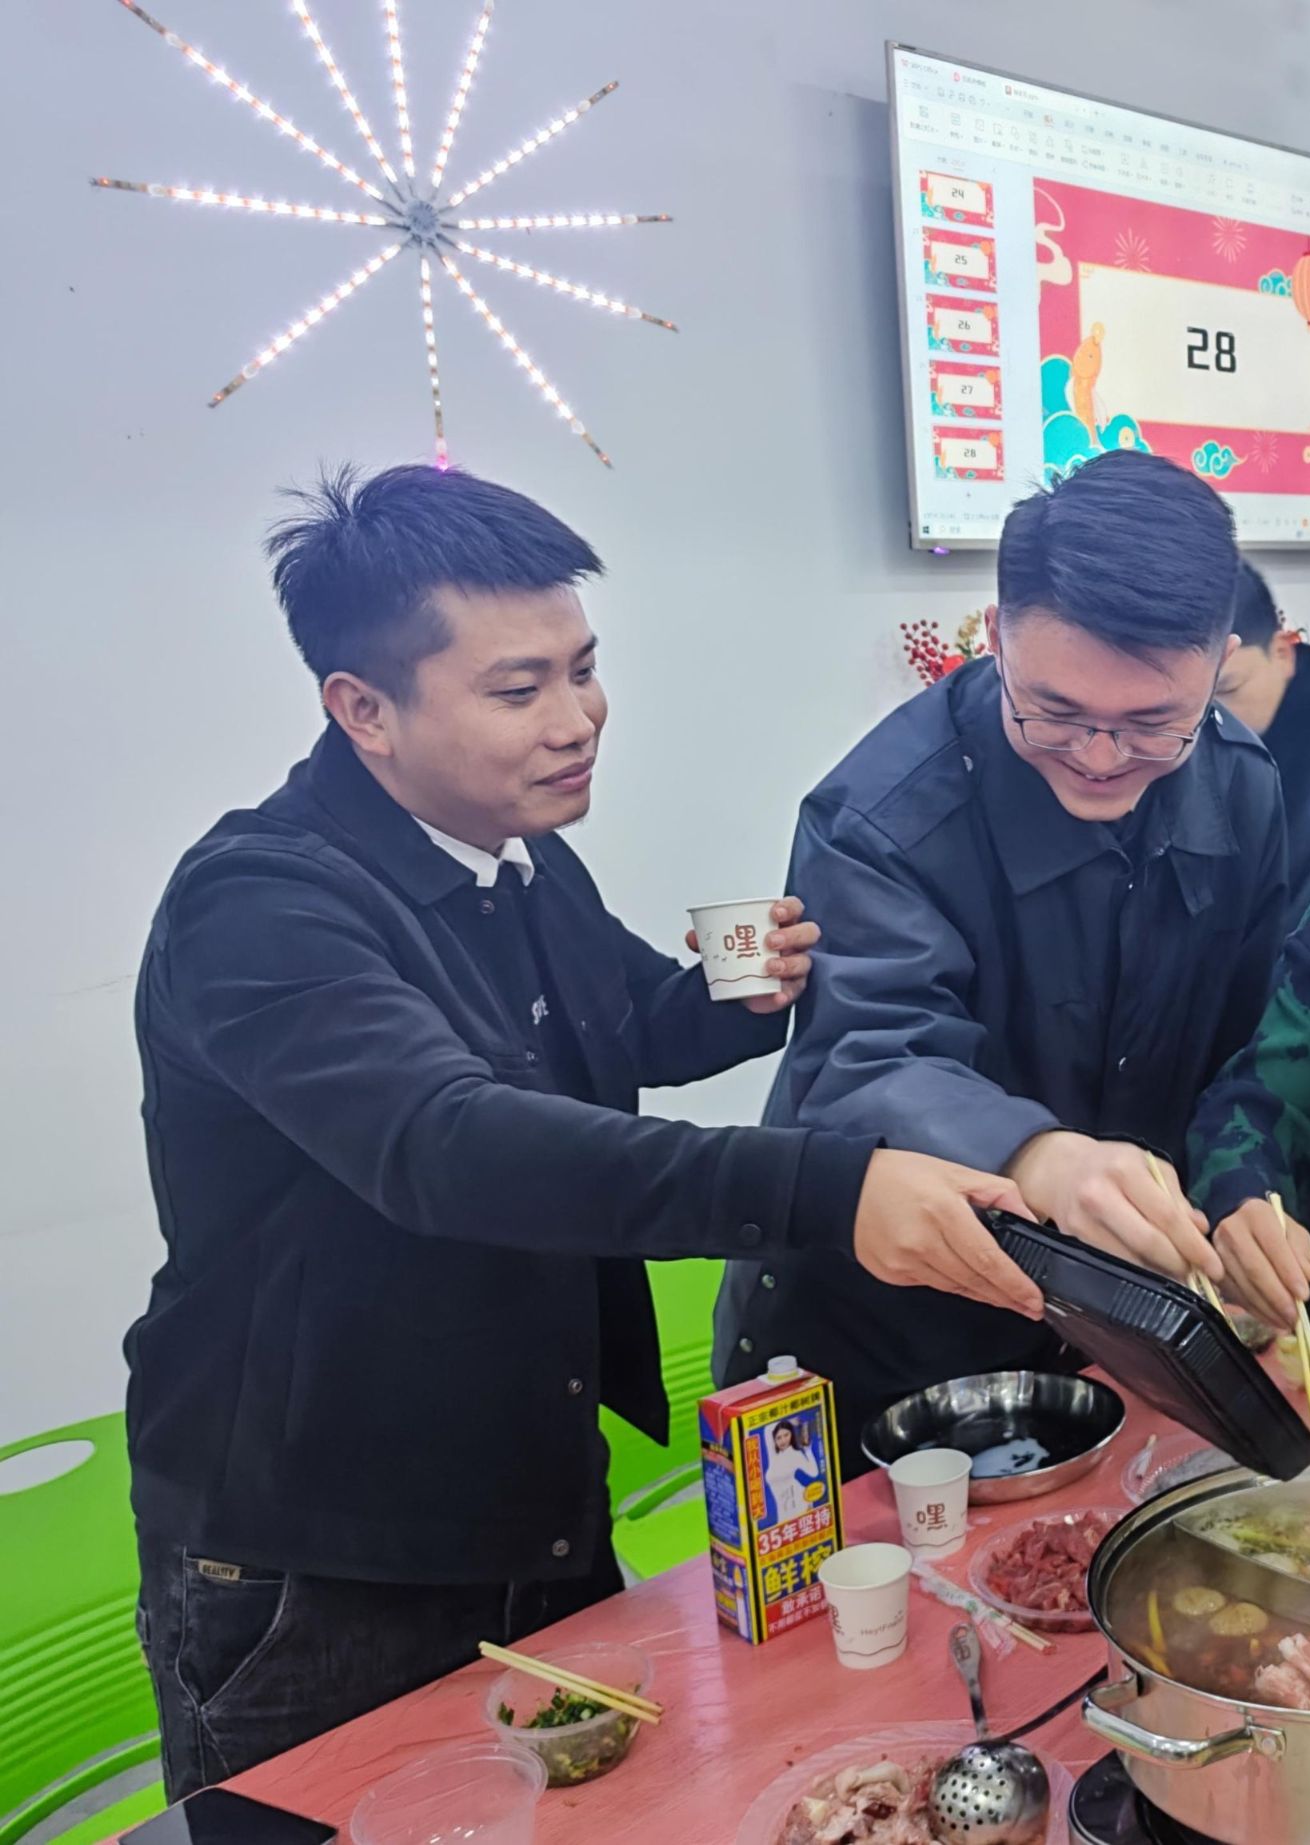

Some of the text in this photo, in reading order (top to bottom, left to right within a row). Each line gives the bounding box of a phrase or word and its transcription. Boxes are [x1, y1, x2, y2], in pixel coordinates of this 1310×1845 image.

[951, 187, 965, 200] 24
[954, 254, 968, 266] 25
[957, 319, 971, 331] 26
[1187, 326, 1237, 373] 28
[960, 384, 974, 396] 27
[963, 447, 977, 459] 28
[758, 1507, 831, 1555] 35年坚持
